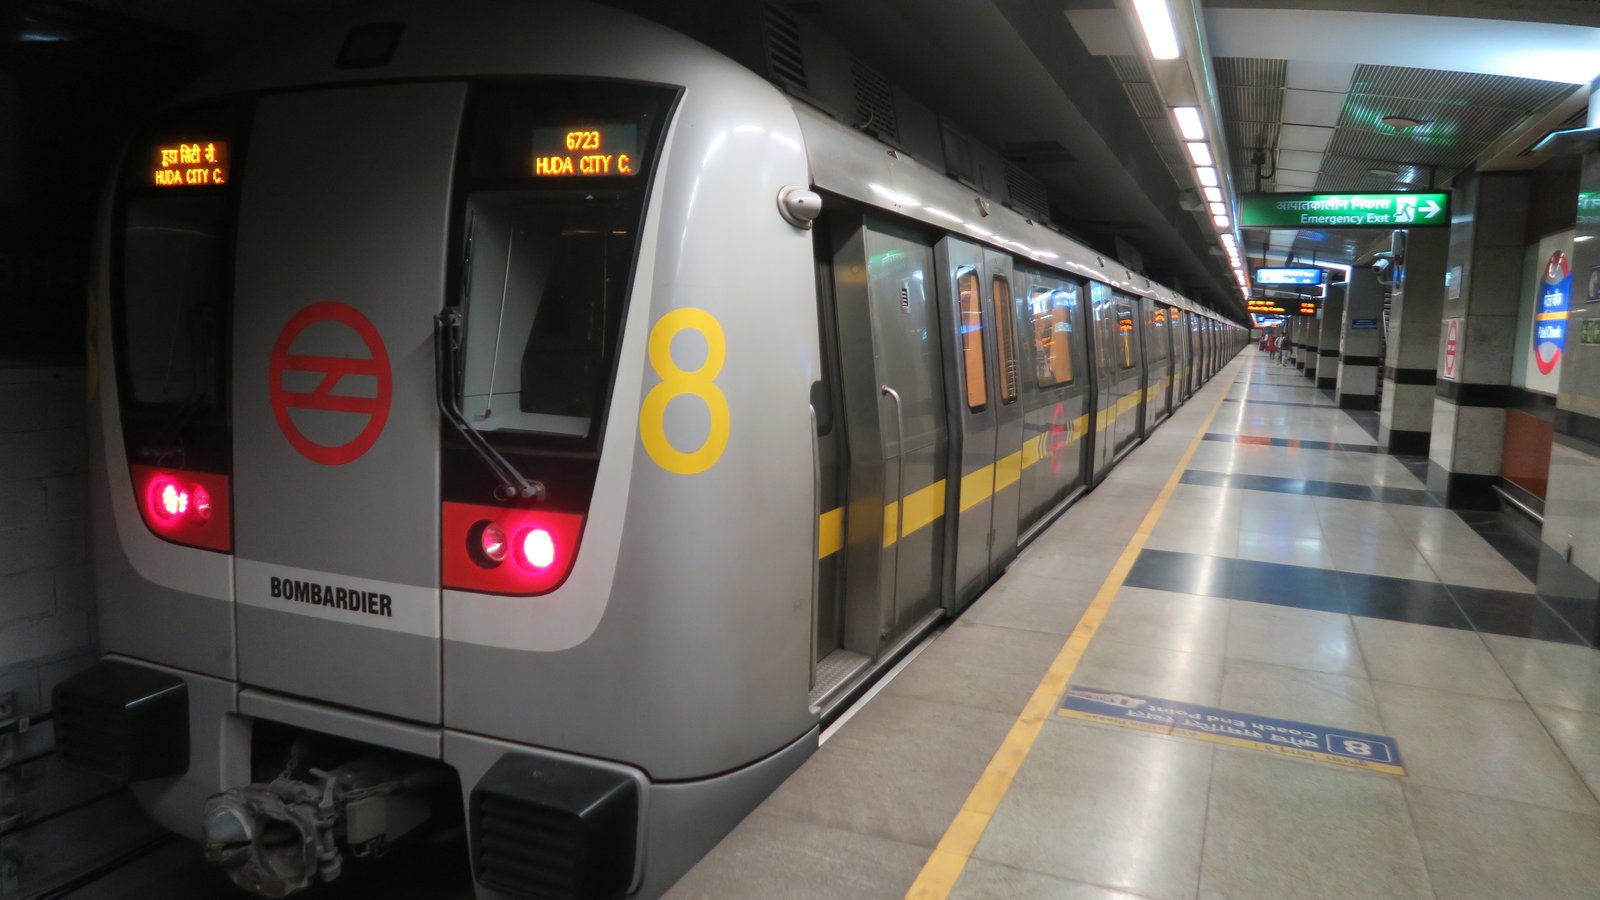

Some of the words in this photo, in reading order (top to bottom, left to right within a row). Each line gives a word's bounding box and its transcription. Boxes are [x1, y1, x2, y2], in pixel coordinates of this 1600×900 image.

[566, 131, 600, 149] 6723
[180, 143, 201, 163] सिटी
[536, 156, 574, 175] HUDA
[580, 155, 612, 173] CITY
[618, 154, 631, 173] C.
[155, 169, 183, 185] HUDA
[186, 168, 209, 184] CITY
[212, 168, 225, 184] C.
[1276, 196, 1349, 210] आपातकालीन
[1350, 196, 1391, 210] निकास
[1301, 213, 1363, 225] Emergency
[1366, 213, 1389, 223] Exit
[639, 307, 731, 475] 8
[271, 576, 392, 617] BOMBARDIER
[1148, 704, 1203, 721] Point
[1207, 714, 1247, 728] End
[1252, 722, 1318, 739] Coach
[1270, 733, 1320, 749] कोच
[1343, 740, 1372, 756] 8
